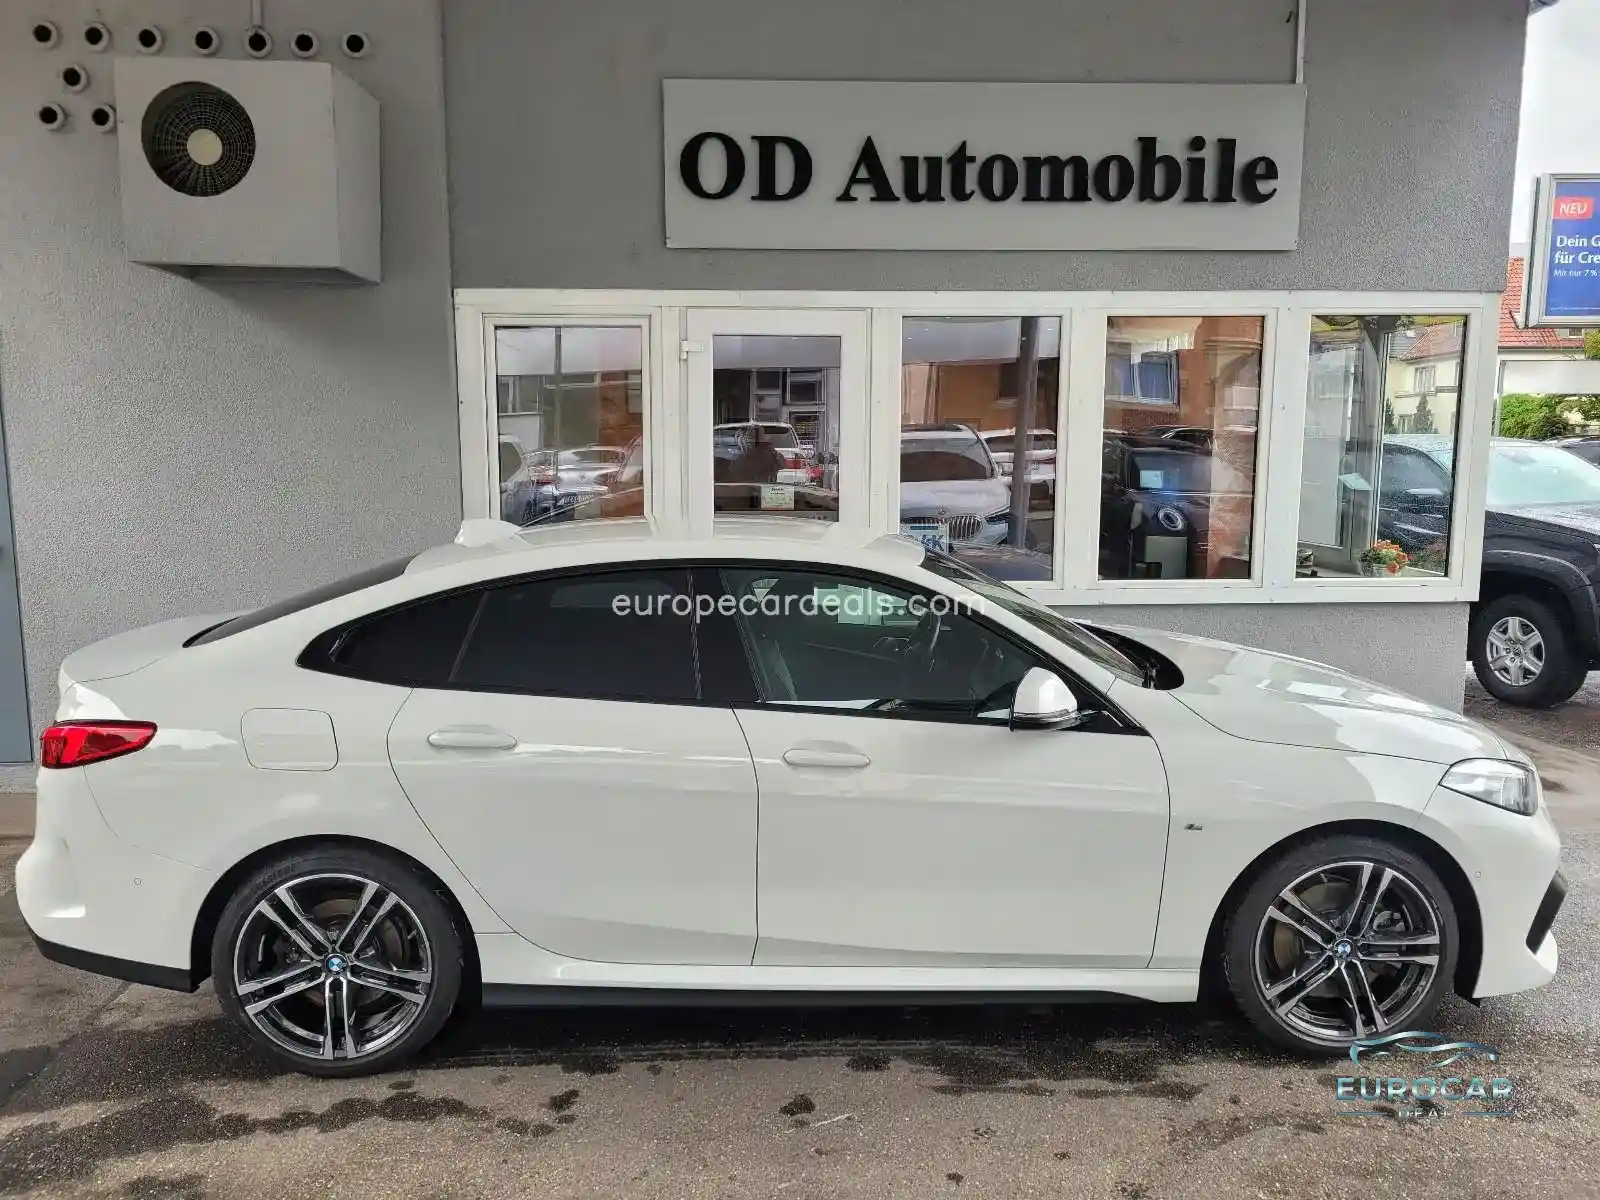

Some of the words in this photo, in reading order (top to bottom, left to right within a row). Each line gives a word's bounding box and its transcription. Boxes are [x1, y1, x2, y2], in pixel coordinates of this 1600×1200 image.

[679, 131, 813, 202] OD
[836, 135, 1279, 205] Automobile
[1559, 202, 1588, 215] NEU
[1556, 234, 1587, 248] Dein
[1554, 250, 1575, 264] für
